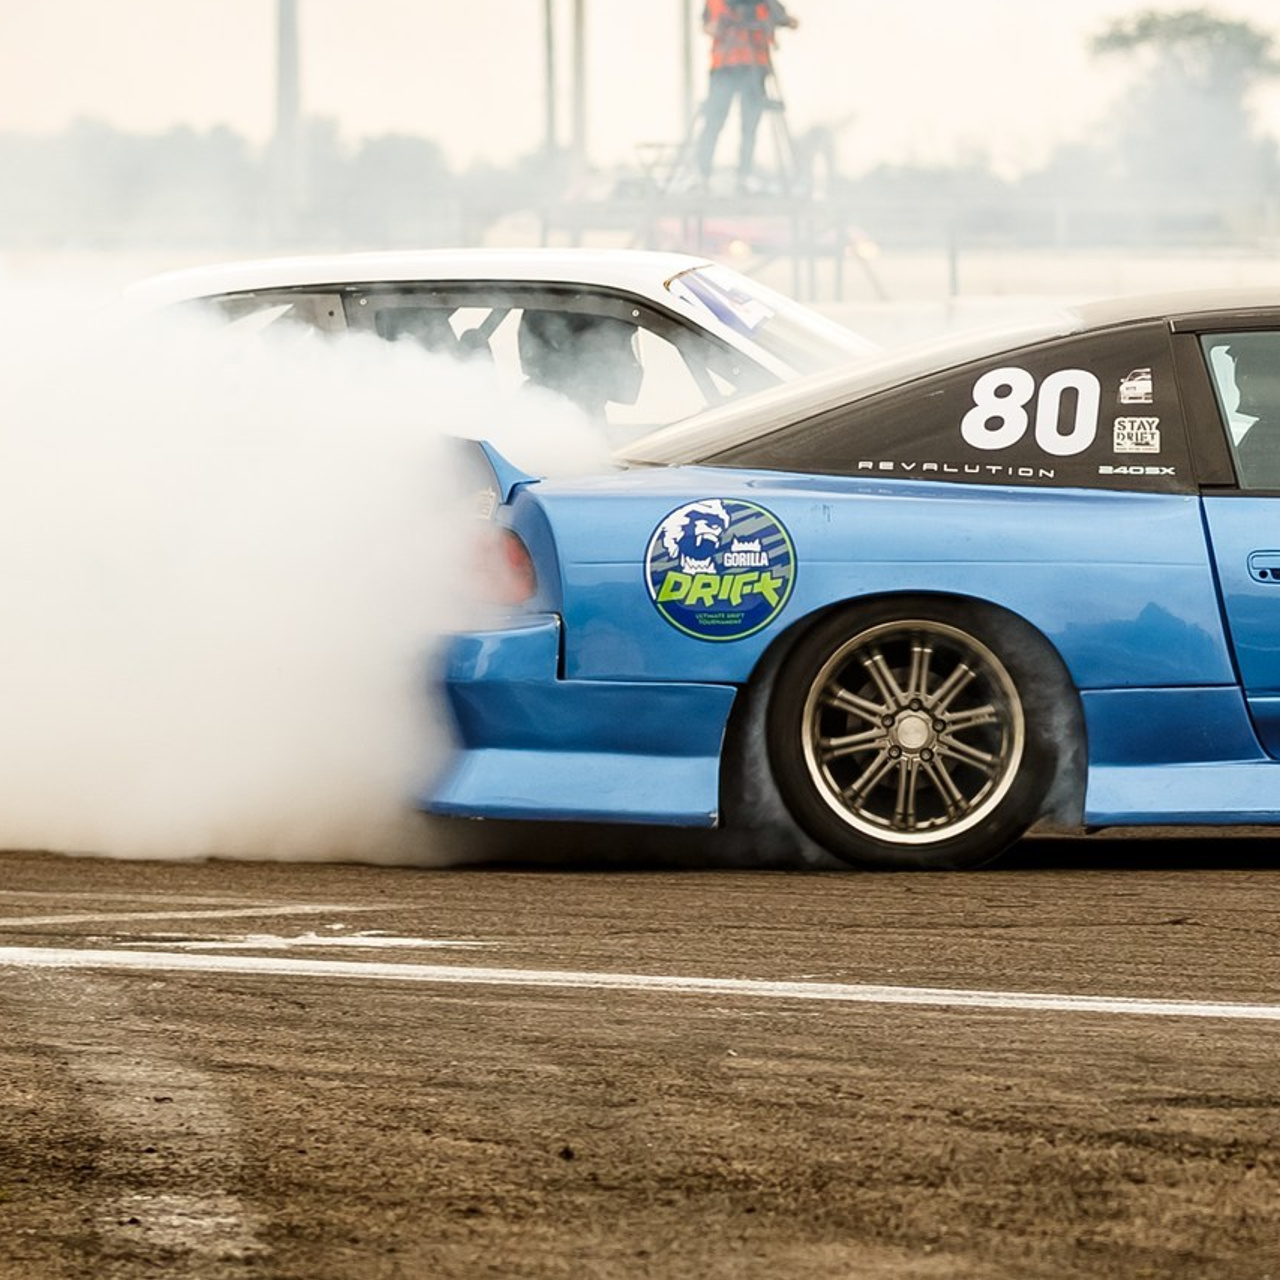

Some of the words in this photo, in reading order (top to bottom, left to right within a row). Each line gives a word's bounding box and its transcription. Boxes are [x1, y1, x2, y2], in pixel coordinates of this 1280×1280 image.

[959, 367, 1101, 457] 80
[1117, 420, 1156, 431] STAY
[1116, 431, 1157, 442] DRIFT
[858, 461, 1054, 478] REVALUTION
[1098, 465, 1175, 475] 240SX
[724, 552, 769, 567] GORILLA
[657, 571, 782, 608] DRIFT
